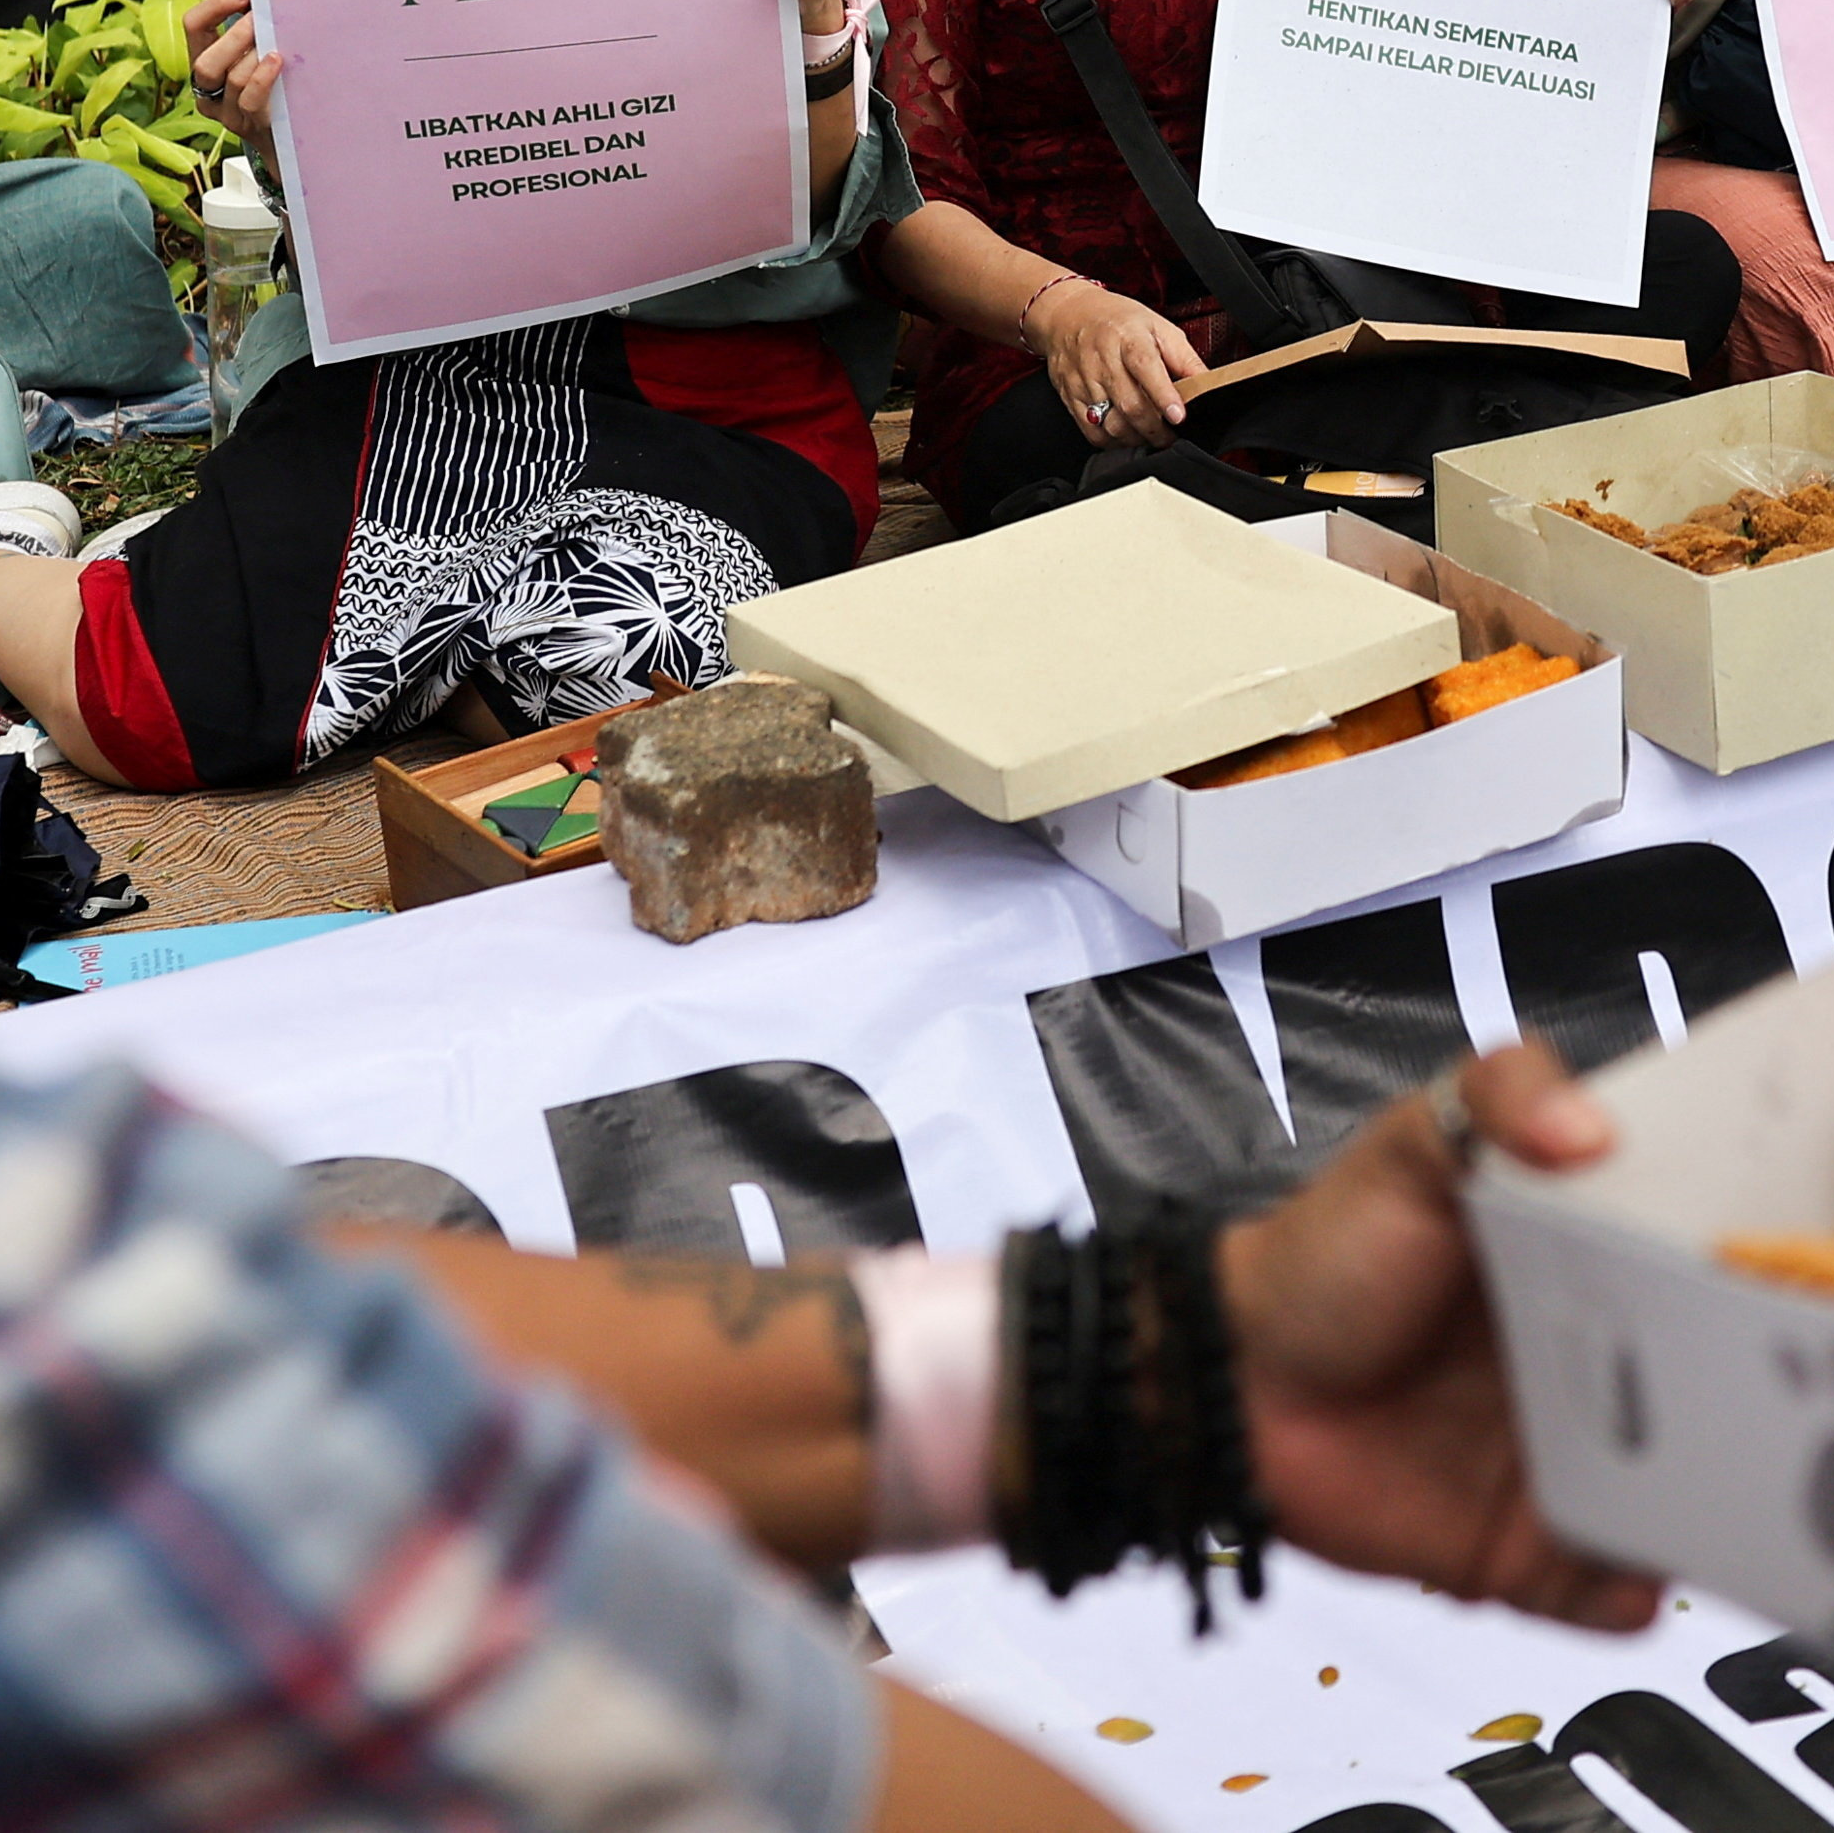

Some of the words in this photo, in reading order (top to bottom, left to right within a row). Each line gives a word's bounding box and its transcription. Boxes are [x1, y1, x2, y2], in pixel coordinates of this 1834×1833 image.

[1433, 20, 1579, 63] SEMENTARA
[1280, 28, 1373, 62] SAMPAI
[1377, 45, 1454, 76] KELAR
[1457, 59, 1596, 102] DIEVALUASI
[404, 108, 547, 139] LIBATKAN
[552, 101, 616, 125] AHLI
[620, 94, 676, 117] GIZI
[443, 139, 580, 170] KREDIBEL
[584, 130, 646, 154] DAN
[452, 163, 648, 202] PROFESIONAL
